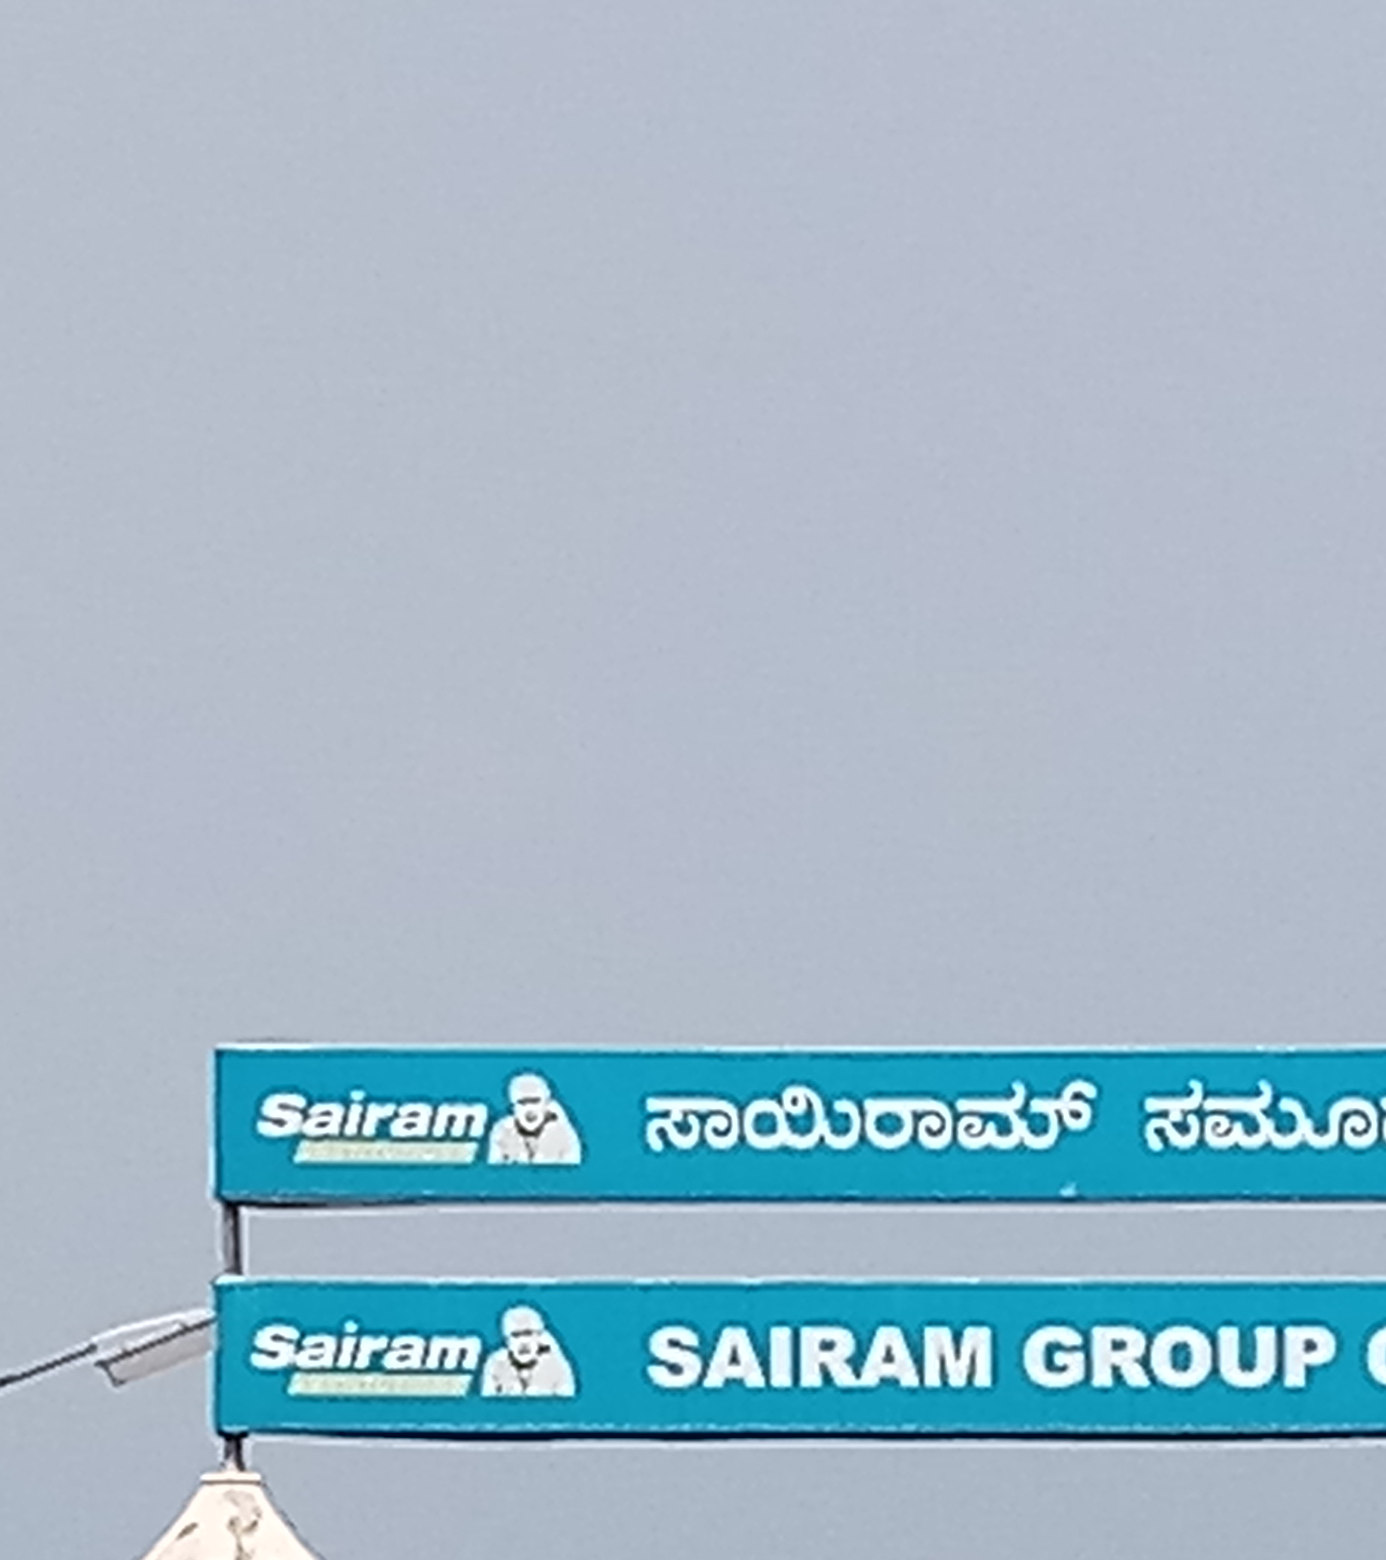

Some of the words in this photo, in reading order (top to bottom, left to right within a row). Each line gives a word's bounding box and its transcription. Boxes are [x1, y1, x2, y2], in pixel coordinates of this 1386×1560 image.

[256, 1090, 489, 1139] Sairam
[645, 1079, 1098, 1152] ಸಾಯಿರಾಮ್
[249, 1321, 483, 1371] Sairam
[647, 1325, 993, 1389] SAIRAM
[1022, 1325, 1337, 1389] GROUP
